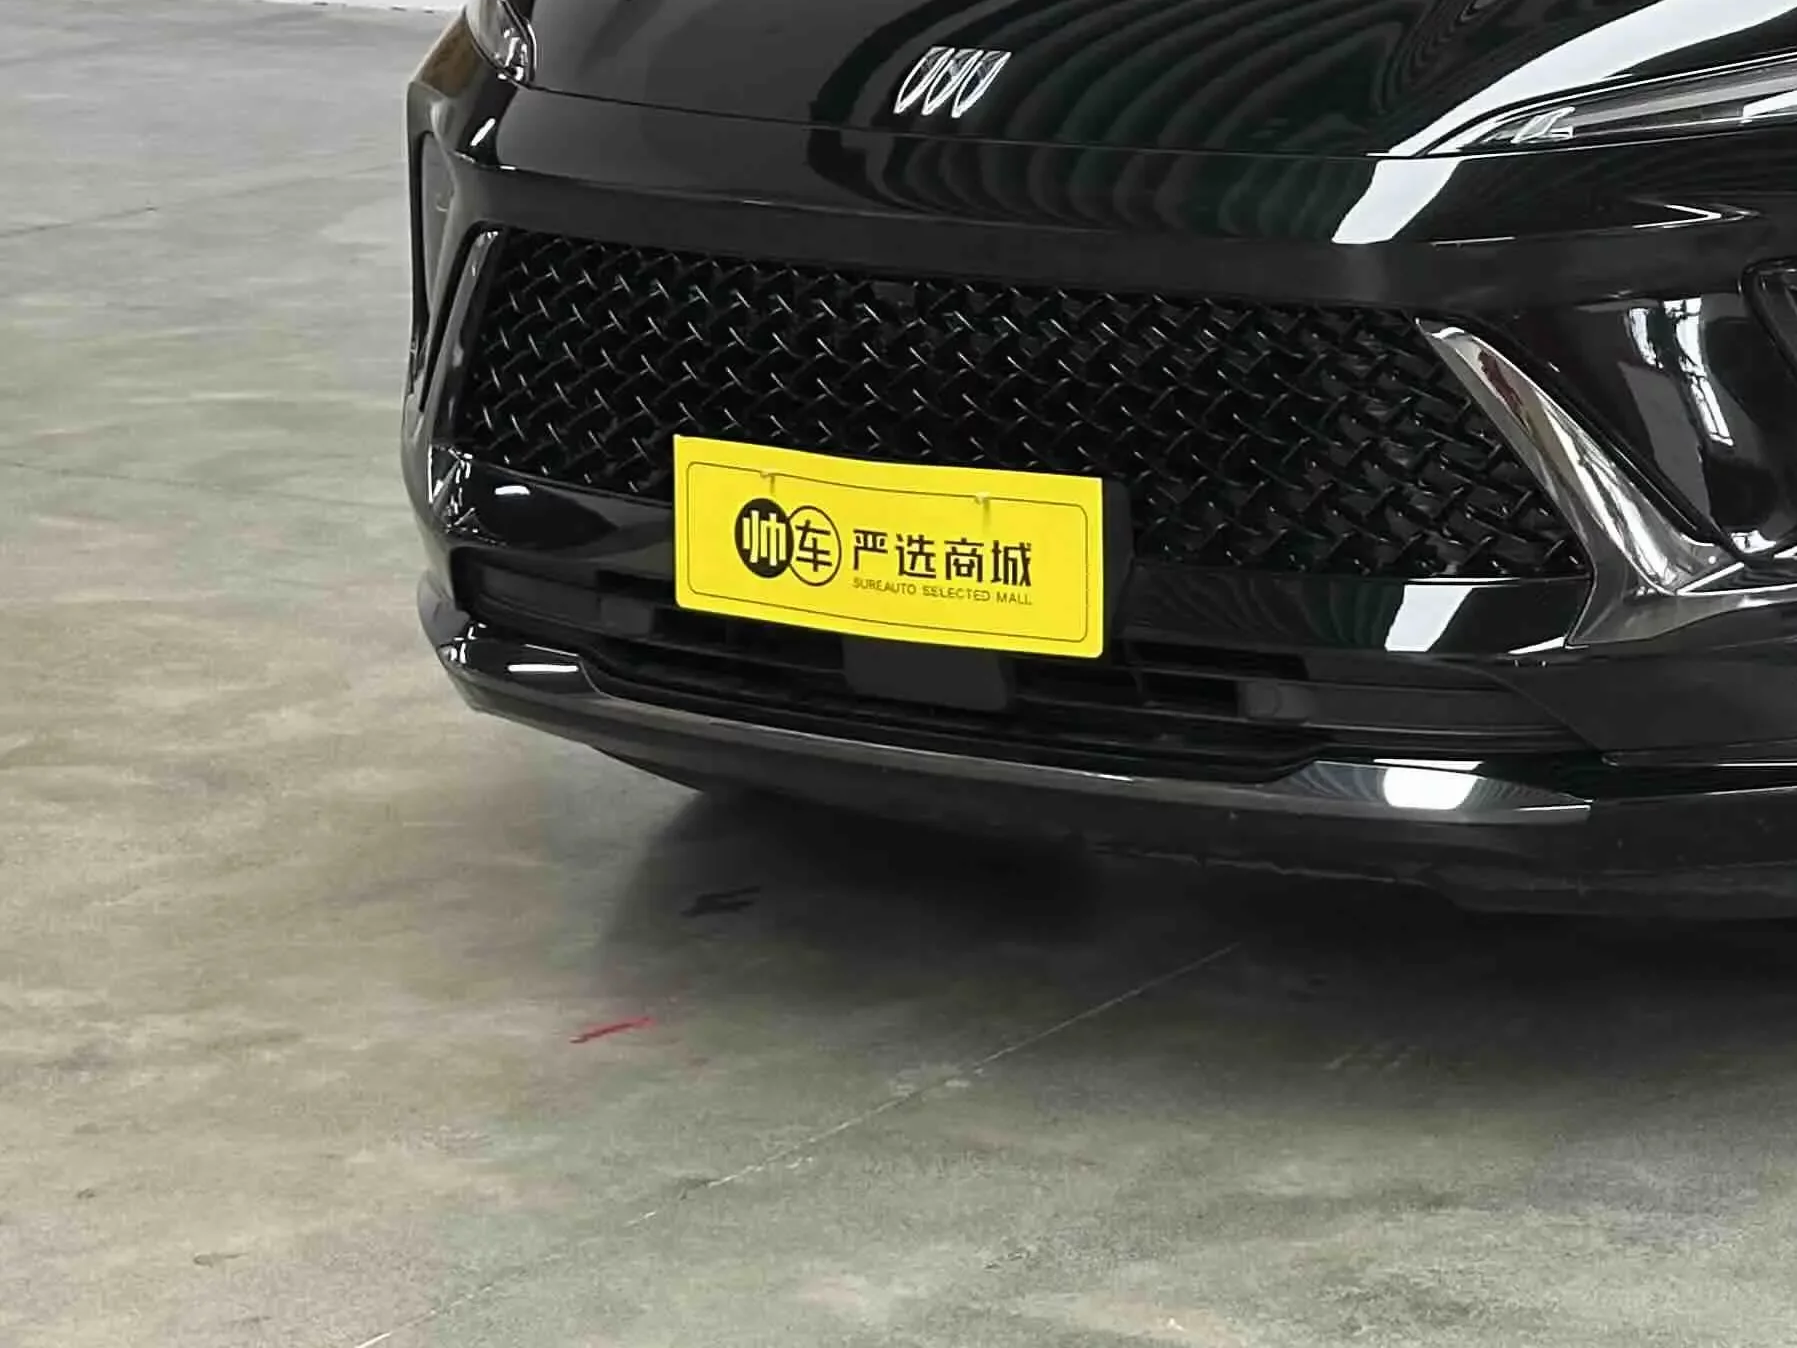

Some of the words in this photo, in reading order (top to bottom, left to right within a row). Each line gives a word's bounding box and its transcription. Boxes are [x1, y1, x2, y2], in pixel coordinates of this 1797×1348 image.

[853, 528, 1032, 587] 严选商城
[852, 576, 917, 596] SUREAUTO
[922, 584, 990, 602] SELECTED
[996, 591, 1032, 605] MALL
